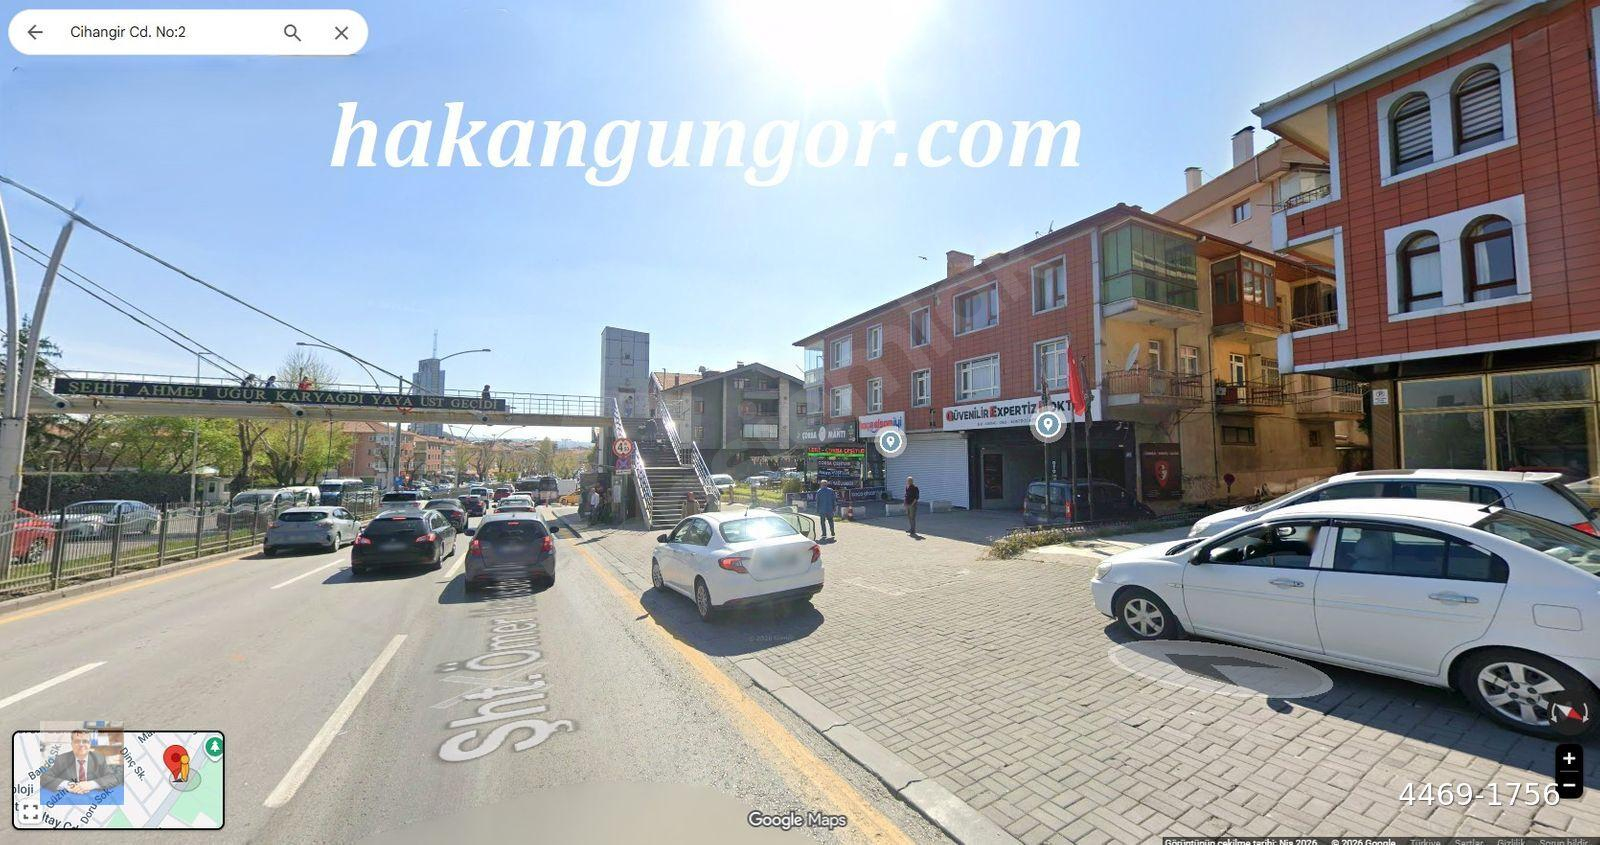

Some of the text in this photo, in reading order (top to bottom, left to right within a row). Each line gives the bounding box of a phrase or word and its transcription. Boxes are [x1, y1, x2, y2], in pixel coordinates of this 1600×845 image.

[68, 380, 129, 395] ŞEHİT
[137, 384, 208, 398] AHMET
[216, 385, 267, 400] UĞUR
[276, 389, 363, 405] KARYAĞDI
[372, 394, 413, 406] YAYA
[946, 406, 989, 422] GÜVENİLİR
[990, 401, 1037, 418] EXPERTİZ
